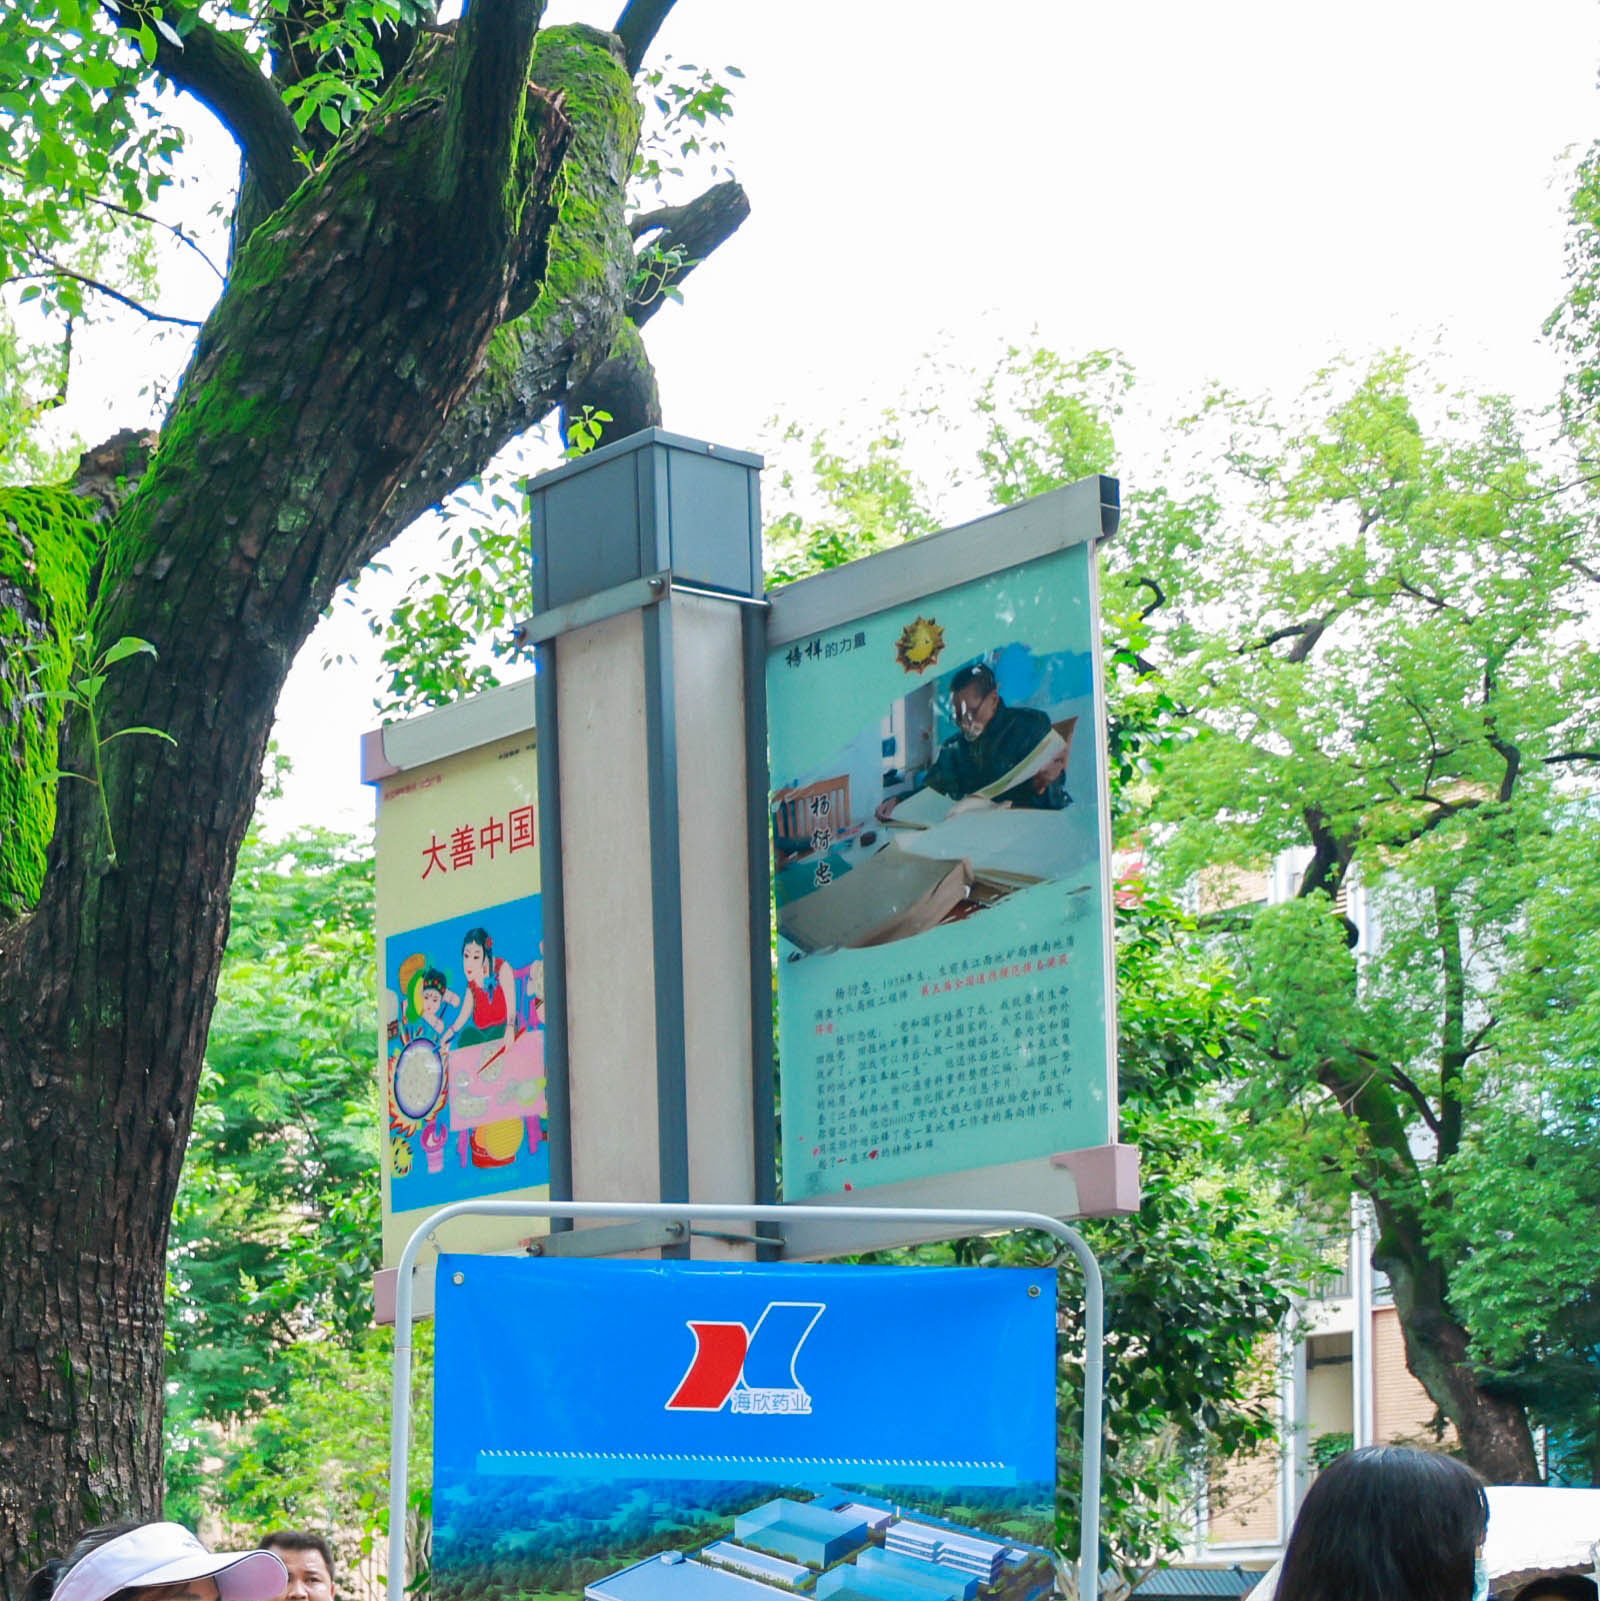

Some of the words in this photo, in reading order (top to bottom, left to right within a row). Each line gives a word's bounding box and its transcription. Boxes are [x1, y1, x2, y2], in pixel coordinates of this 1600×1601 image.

[421, 804, 535, 880] 大善中国
[730, 1390, 812, 1415] 海欣药业
